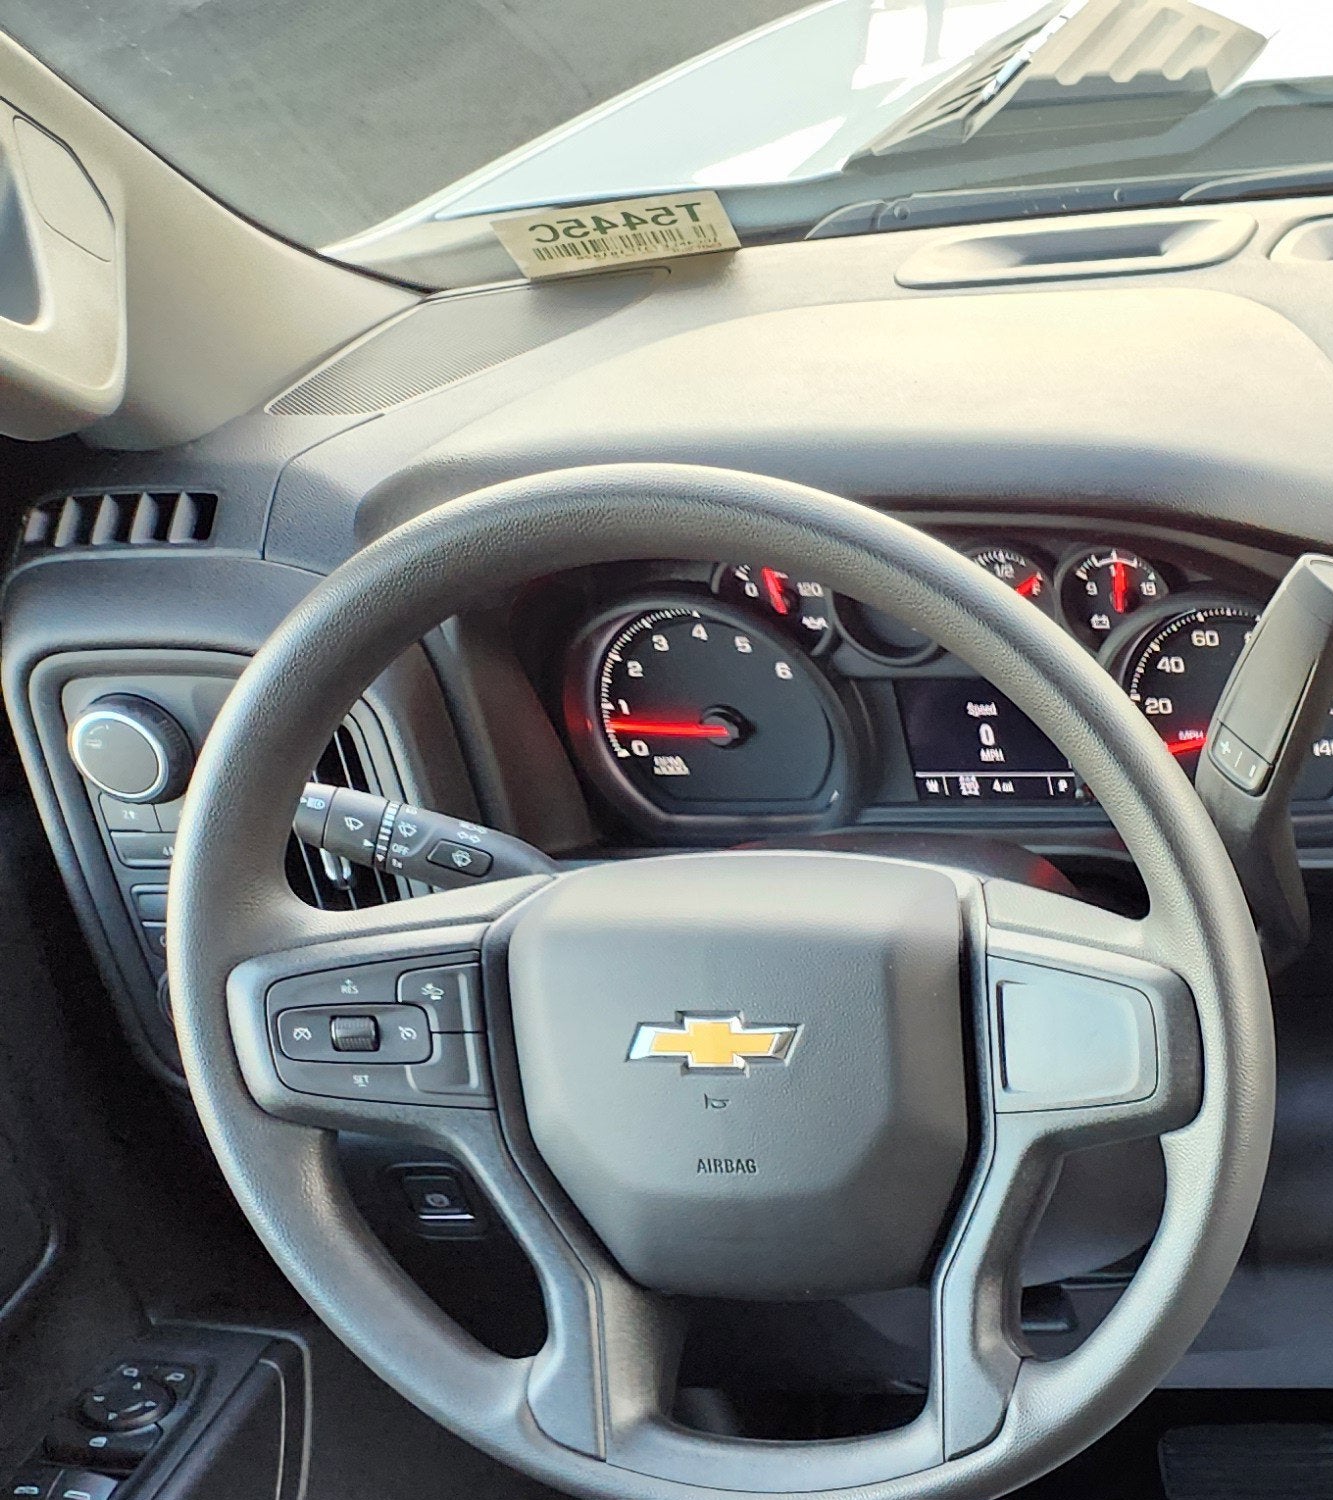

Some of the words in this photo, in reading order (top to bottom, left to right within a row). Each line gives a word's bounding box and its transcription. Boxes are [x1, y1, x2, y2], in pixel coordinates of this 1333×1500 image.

[1086, 582, 1098, 596] 9
[1140, 582, 1157, 596] 19
[692, 623, 708, 641] 4
[1191, 630, 1219, 647] 60
[652, 634, 670, 652] 3
[734, 635, 752, 653] 5
[626, 660, 644, 678] 2
[775, 661, 793, 679] 6
[1157, 656, 1185, 673] 40
[618, 698, 630, 715] 1
[966, 701, 998, 717] Speed
[1145, 697, 1173, 714] 20
[979, 722, 995, 746] 0
[1178, 730, 1204, 740] MPH
[631, 739, 650, 757] 0
[980, 749, 1006, 762] MPH
[1057, 779, 1068, 793] P
[340, 984, 359, 994] RES
[353, 1075, 369, 1084] SET
[697, 1158, 757, 1174] AIRBAG
